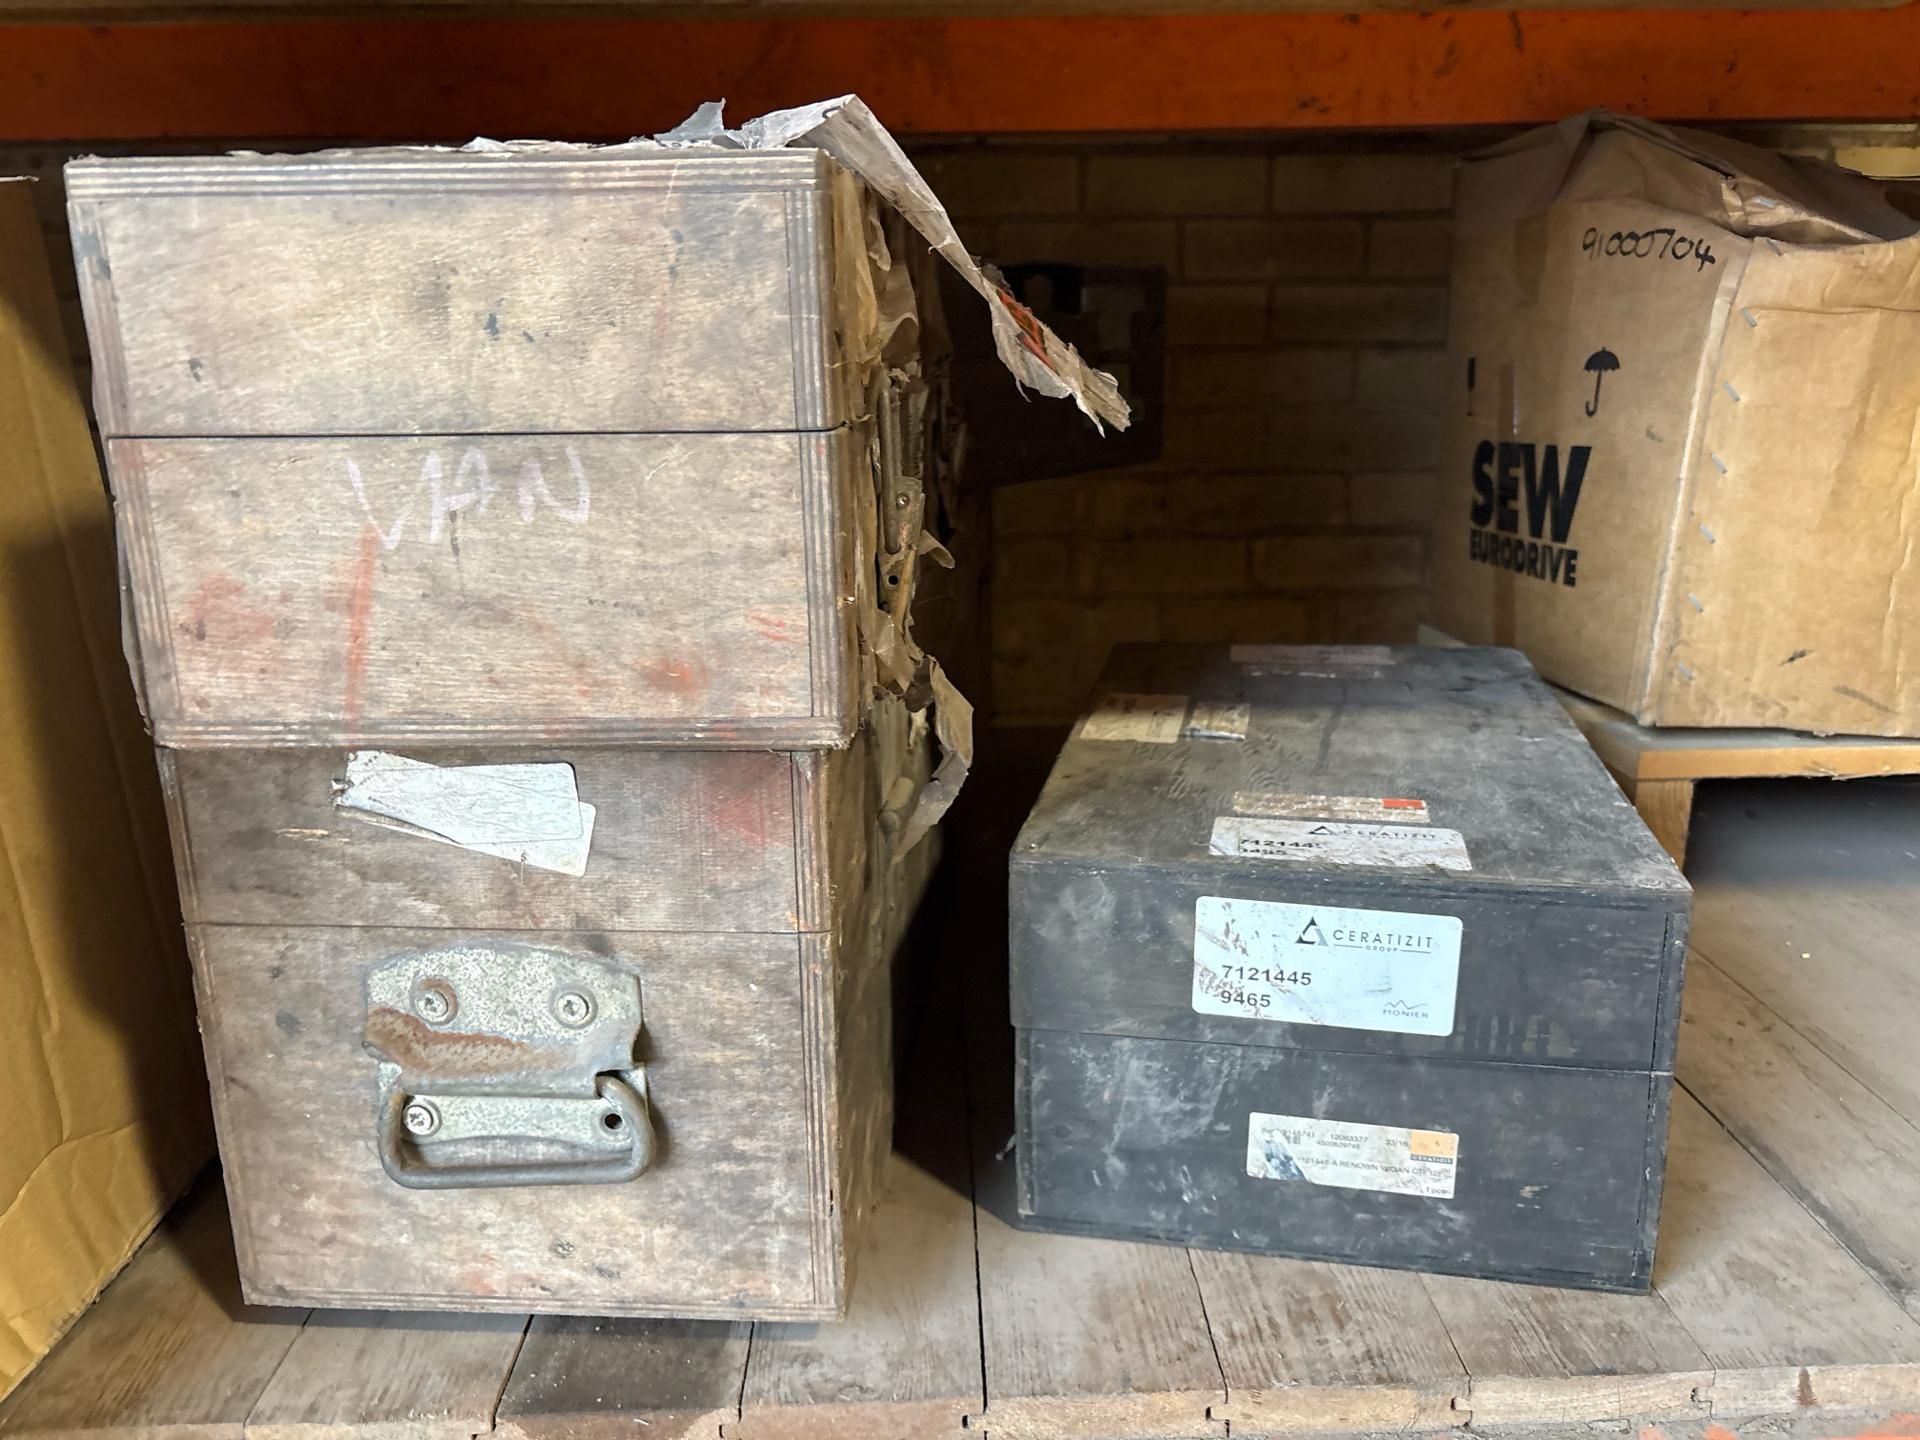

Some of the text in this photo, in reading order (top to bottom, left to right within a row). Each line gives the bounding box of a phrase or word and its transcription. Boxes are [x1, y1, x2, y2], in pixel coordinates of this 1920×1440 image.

[1582, 227, 1716, 273] 91000704
[346, 446, 592, 550] VAN
[1470, 440, 1593, 544] SEW
[1469, 528, 1578, 588] EURODRIVE
[1332, 928, 1434, 949] CERATIZIT
[1365, 945, 1399, 953] GROUP
[1221, 964, 1313, 987] 7121445
[1220, 989, 1272, 1009] 9465
[1382, 1008, 1430, 1019] MONIER
